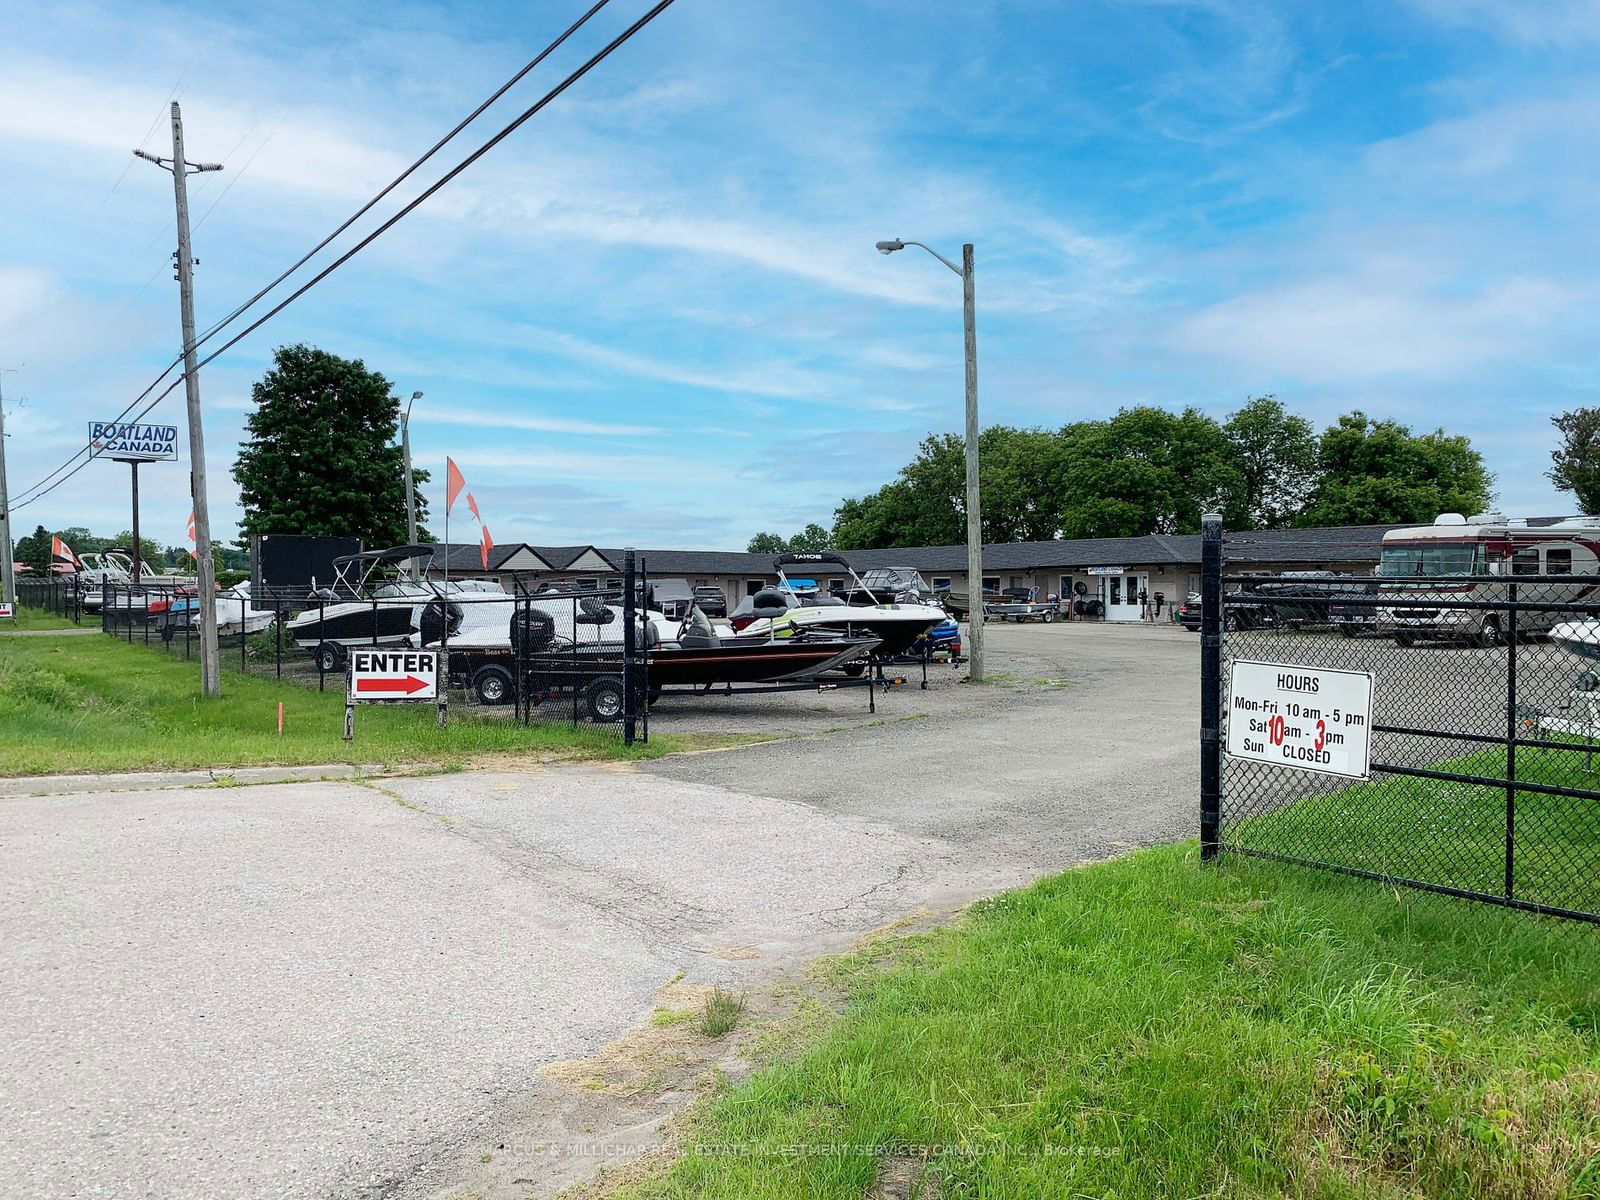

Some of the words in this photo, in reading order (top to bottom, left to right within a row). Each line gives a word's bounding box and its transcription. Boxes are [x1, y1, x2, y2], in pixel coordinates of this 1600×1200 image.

[92, 423, 176, 442] BOATLAND
[105, 440, 174, 453] CANADA
[355, 653, 433, 672] ENTER
[1277, 673, 1320, 692] HOURS
[1234, 696, 1278, 714] Mon-Fri
[1286, 703, 1300, 717] 10
[1302, 707, 1321, 719] am
[1333, 709, 1341, 722] 5
[1345, 713, 1364, 727] pm
[1249, 718, 1268, 733] Sat
[1268, 715, 1285, 746] 10
[1284, 726, 1301, 738] am
[1314, 719, 1326, 752] 3
[1325, 732, 1344, 745] pm
[1243, 737, 1265, 753] Sun
[1282, 744, 1331, 764] CLOSED
